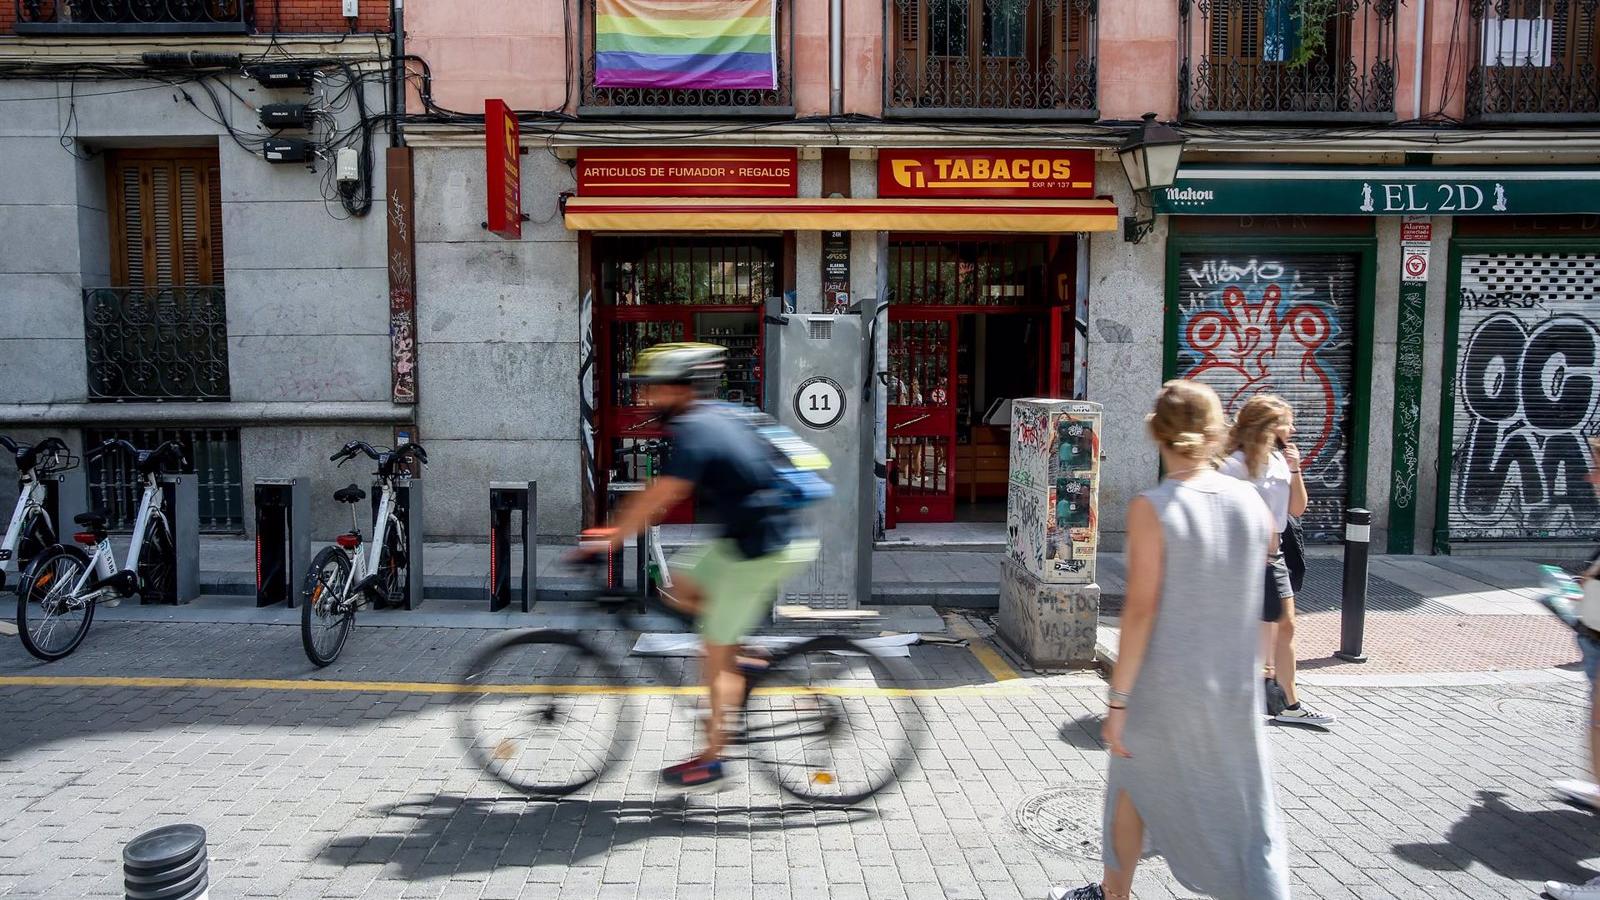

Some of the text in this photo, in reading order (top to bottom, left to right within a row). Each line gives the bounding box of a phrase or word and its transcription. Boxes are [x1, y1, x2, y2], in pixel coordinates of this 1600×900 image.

[583, 167, 791, 177] ARTICULOS DE FUMADOR REGALOS
[934, 159, 1071, 180] TABACOS
[1165, 187, 1214, 200] Mahou
[1382, 184, 1484, 211] EL 2D
[809, 394, 831, 410] 11
